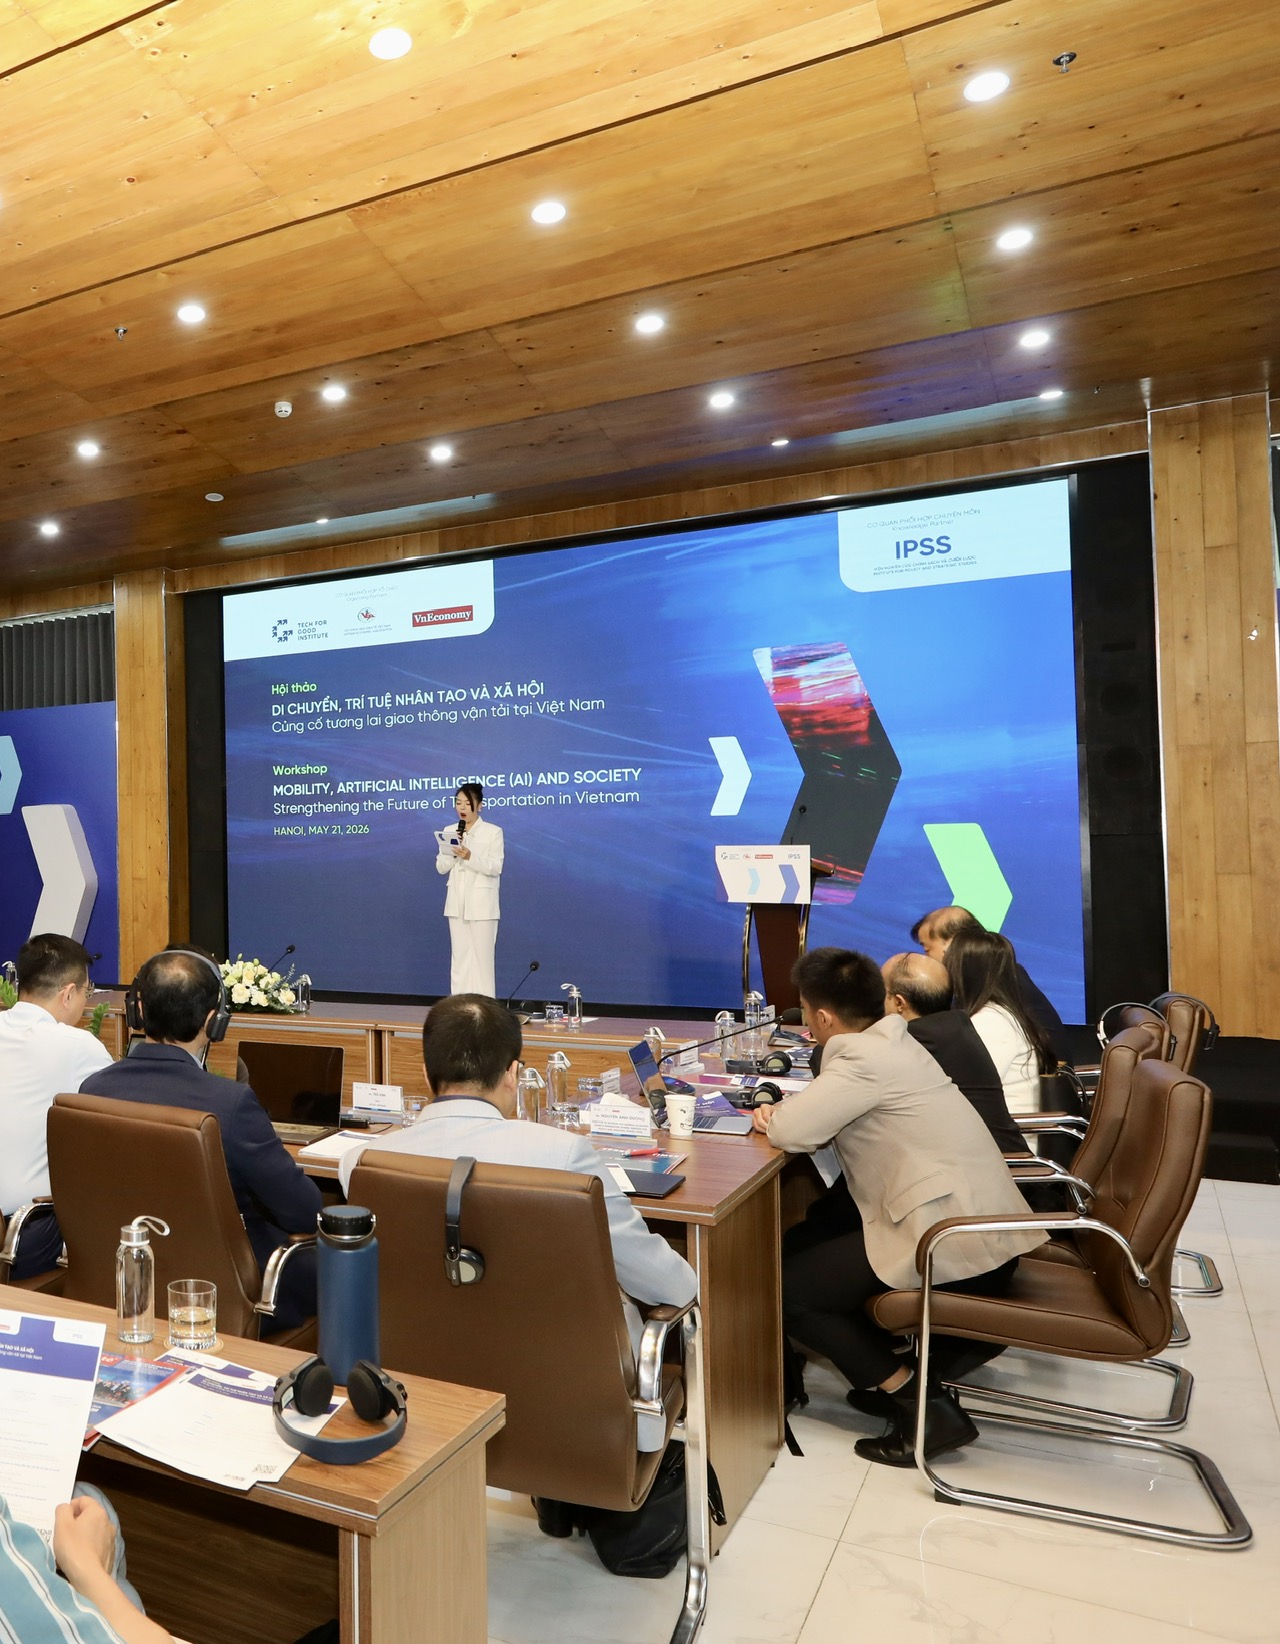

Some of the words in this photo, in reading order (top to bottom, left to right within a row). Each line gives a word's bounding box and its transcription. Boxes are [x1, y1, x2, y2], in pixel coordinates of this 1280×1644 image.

[934, 511, 962, 520] CHUYÊN
[895, 535, 952, 560] IPSS
[414, 608, 472, 624] VnEconomy
[298, 632, 328, 640] INSTITUTE
[272, 684, 288, 696] Hội
[291, 682, 317, 693] thảo
[272, 704, 284, 716] DI
[288, 696, 342, 715] CHUYỂN,
[345, 694, 365, 710] TRÍ
[368, 692, 392, 710] TUỆ
[395, 690, 434, 706] NHÂN
[437, 688, 467, 705] TẠO
[470, 684, 490, 700] VÀ
[494, 682, 514, 699] XÃ
[517, 680, 544, 698] HỘI
[272, 720, 304, 734] Củng
[308, 716, 324, 730] cố
[326, 716, 364, 730] tương
[366, 714, 382, 726] lai
[385, 712, 415, 728] giao
[418, 709, 458, 724] thông
[461, 706, 488, 721] vận
[490, 704, 510, 718] tải
[514, 702, 533, 718] tại
[536, 700, 565, 716] Việt
[569, 698, 605, 712] Nam
[272, 764, 328, 776] Workshop
[273, 782, 334, 797] MOBILITY,
[336, 779, 406, 794] ARTIFICIAL
[509, 772, 533, 788] (AI)
[536, 772, 570, 786] AND
[573, 768, 642, 784] SOCIETY
[273, 801, 360, 816] Strengthening
[362, 800, 384, 812] the
[388, 798, 429, 810] Future
[432, 796, 446, 809] of
[448, 792, 554, 810] Tsportation
[558, 792, 571, 805] in
[575, 790, 640, 804] Vietnam
[274, 826, 306, 836] HANOI,
[308, 826, 330, 835] MAY
[332, 825, 343, 836] 21,
[346, 824, 370, 834] 2026
